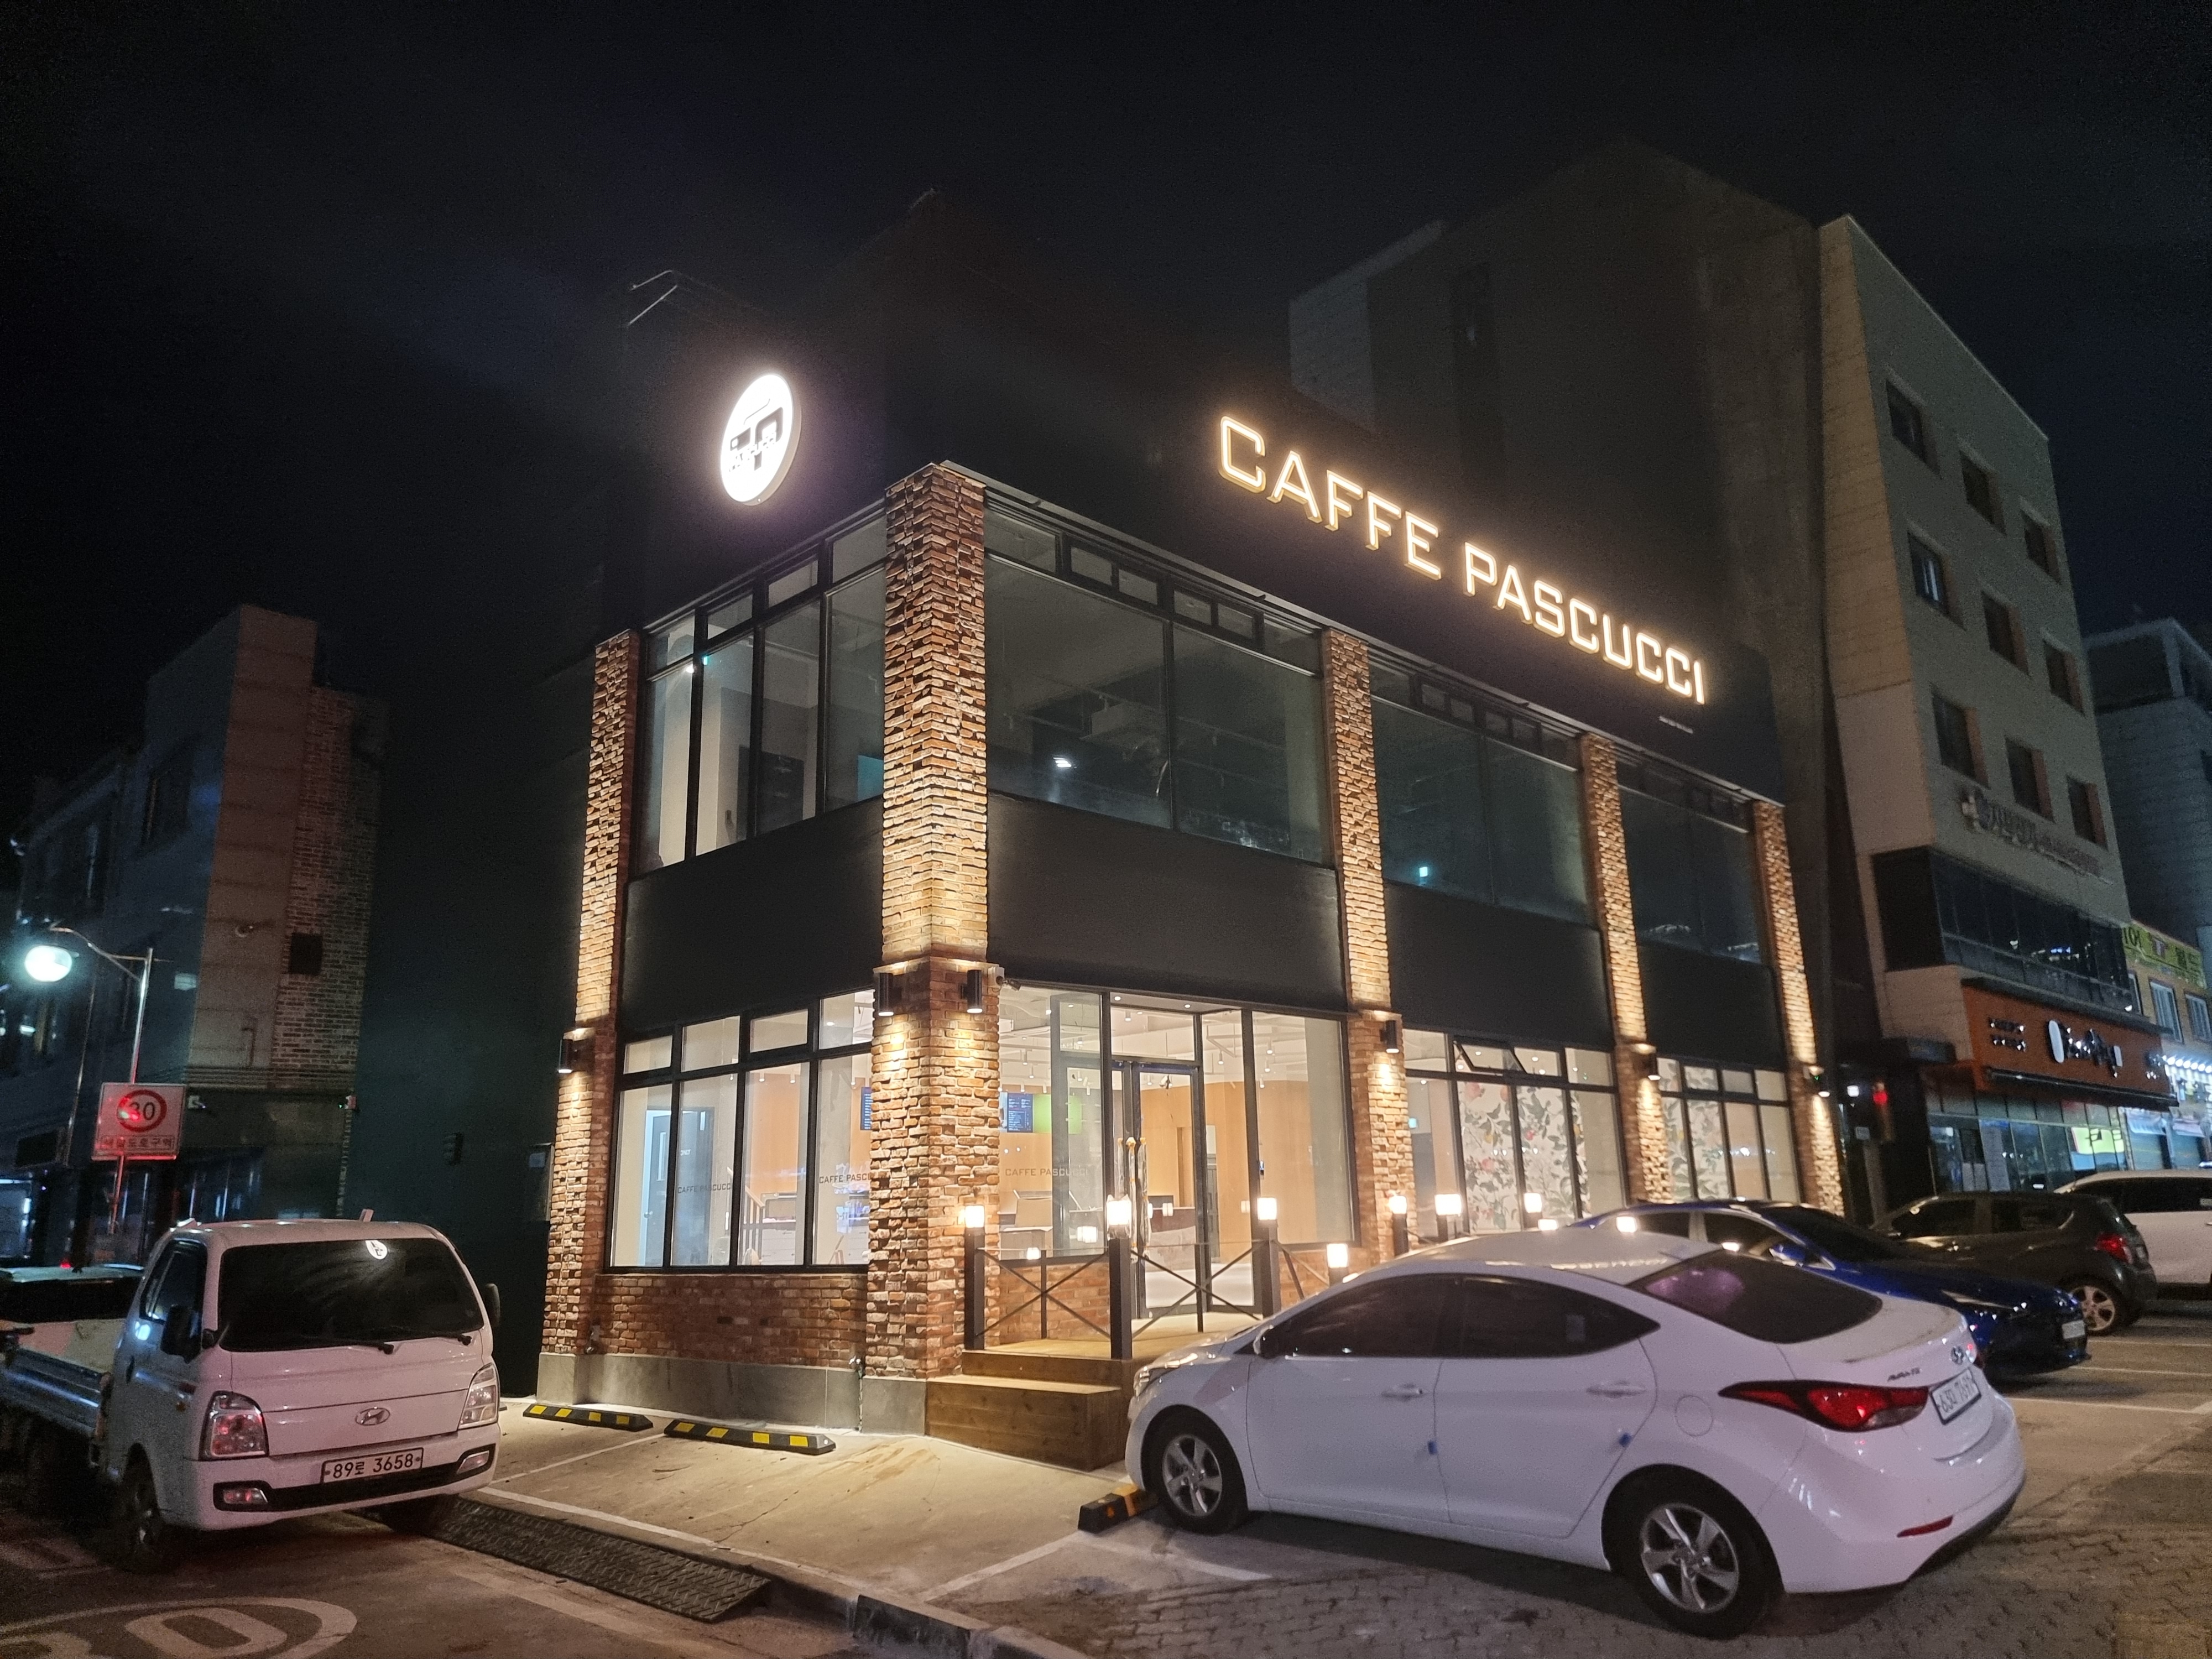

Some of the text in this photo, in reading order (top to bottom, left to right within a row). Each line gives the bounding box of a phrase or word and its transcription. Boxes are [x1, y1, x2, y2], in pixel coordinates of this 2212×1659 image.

[1218, 416, 1705, 706] CAFFE PASCUCCI
[819, 1175, 843, 1184] CAFFE
[1005, 1167, 1089, 1177] CAFFE PASCUCCI
[333, 1453, 414, 1479] 89로 3658
